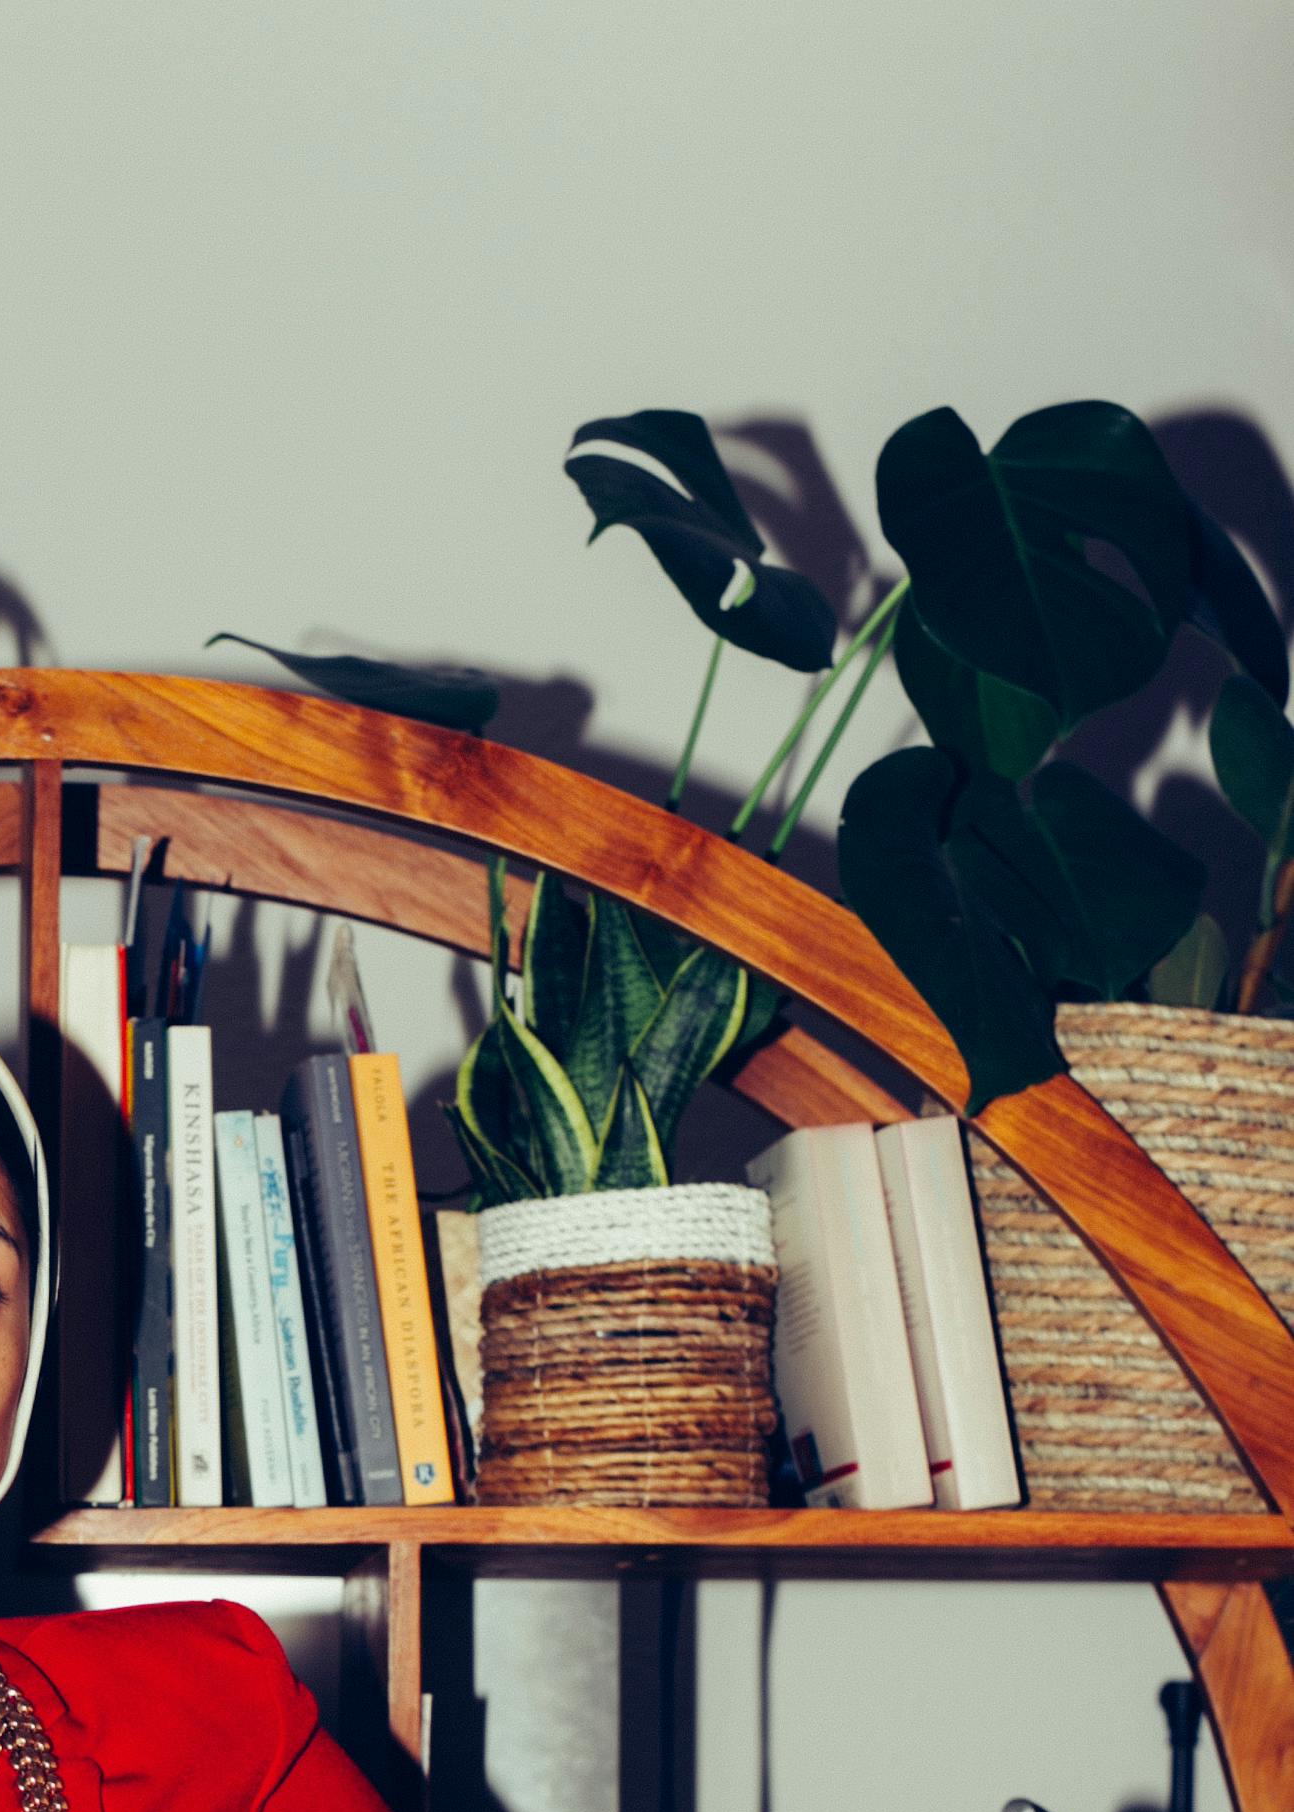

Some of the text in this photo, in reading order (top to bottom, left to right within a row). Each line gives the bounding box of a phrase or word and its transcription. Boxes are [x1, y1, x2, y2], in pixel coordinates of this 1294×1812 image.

[371, 1067, 388, 1123] FALOLA
[183, 1082, 203, 1216] KINSHASA
[269, 1232, 296, 1288] Fury
[380, 1161, 425, 1431] THE AFRICAN DIASPORA
[279, 1316, 298, 1370] Salman
